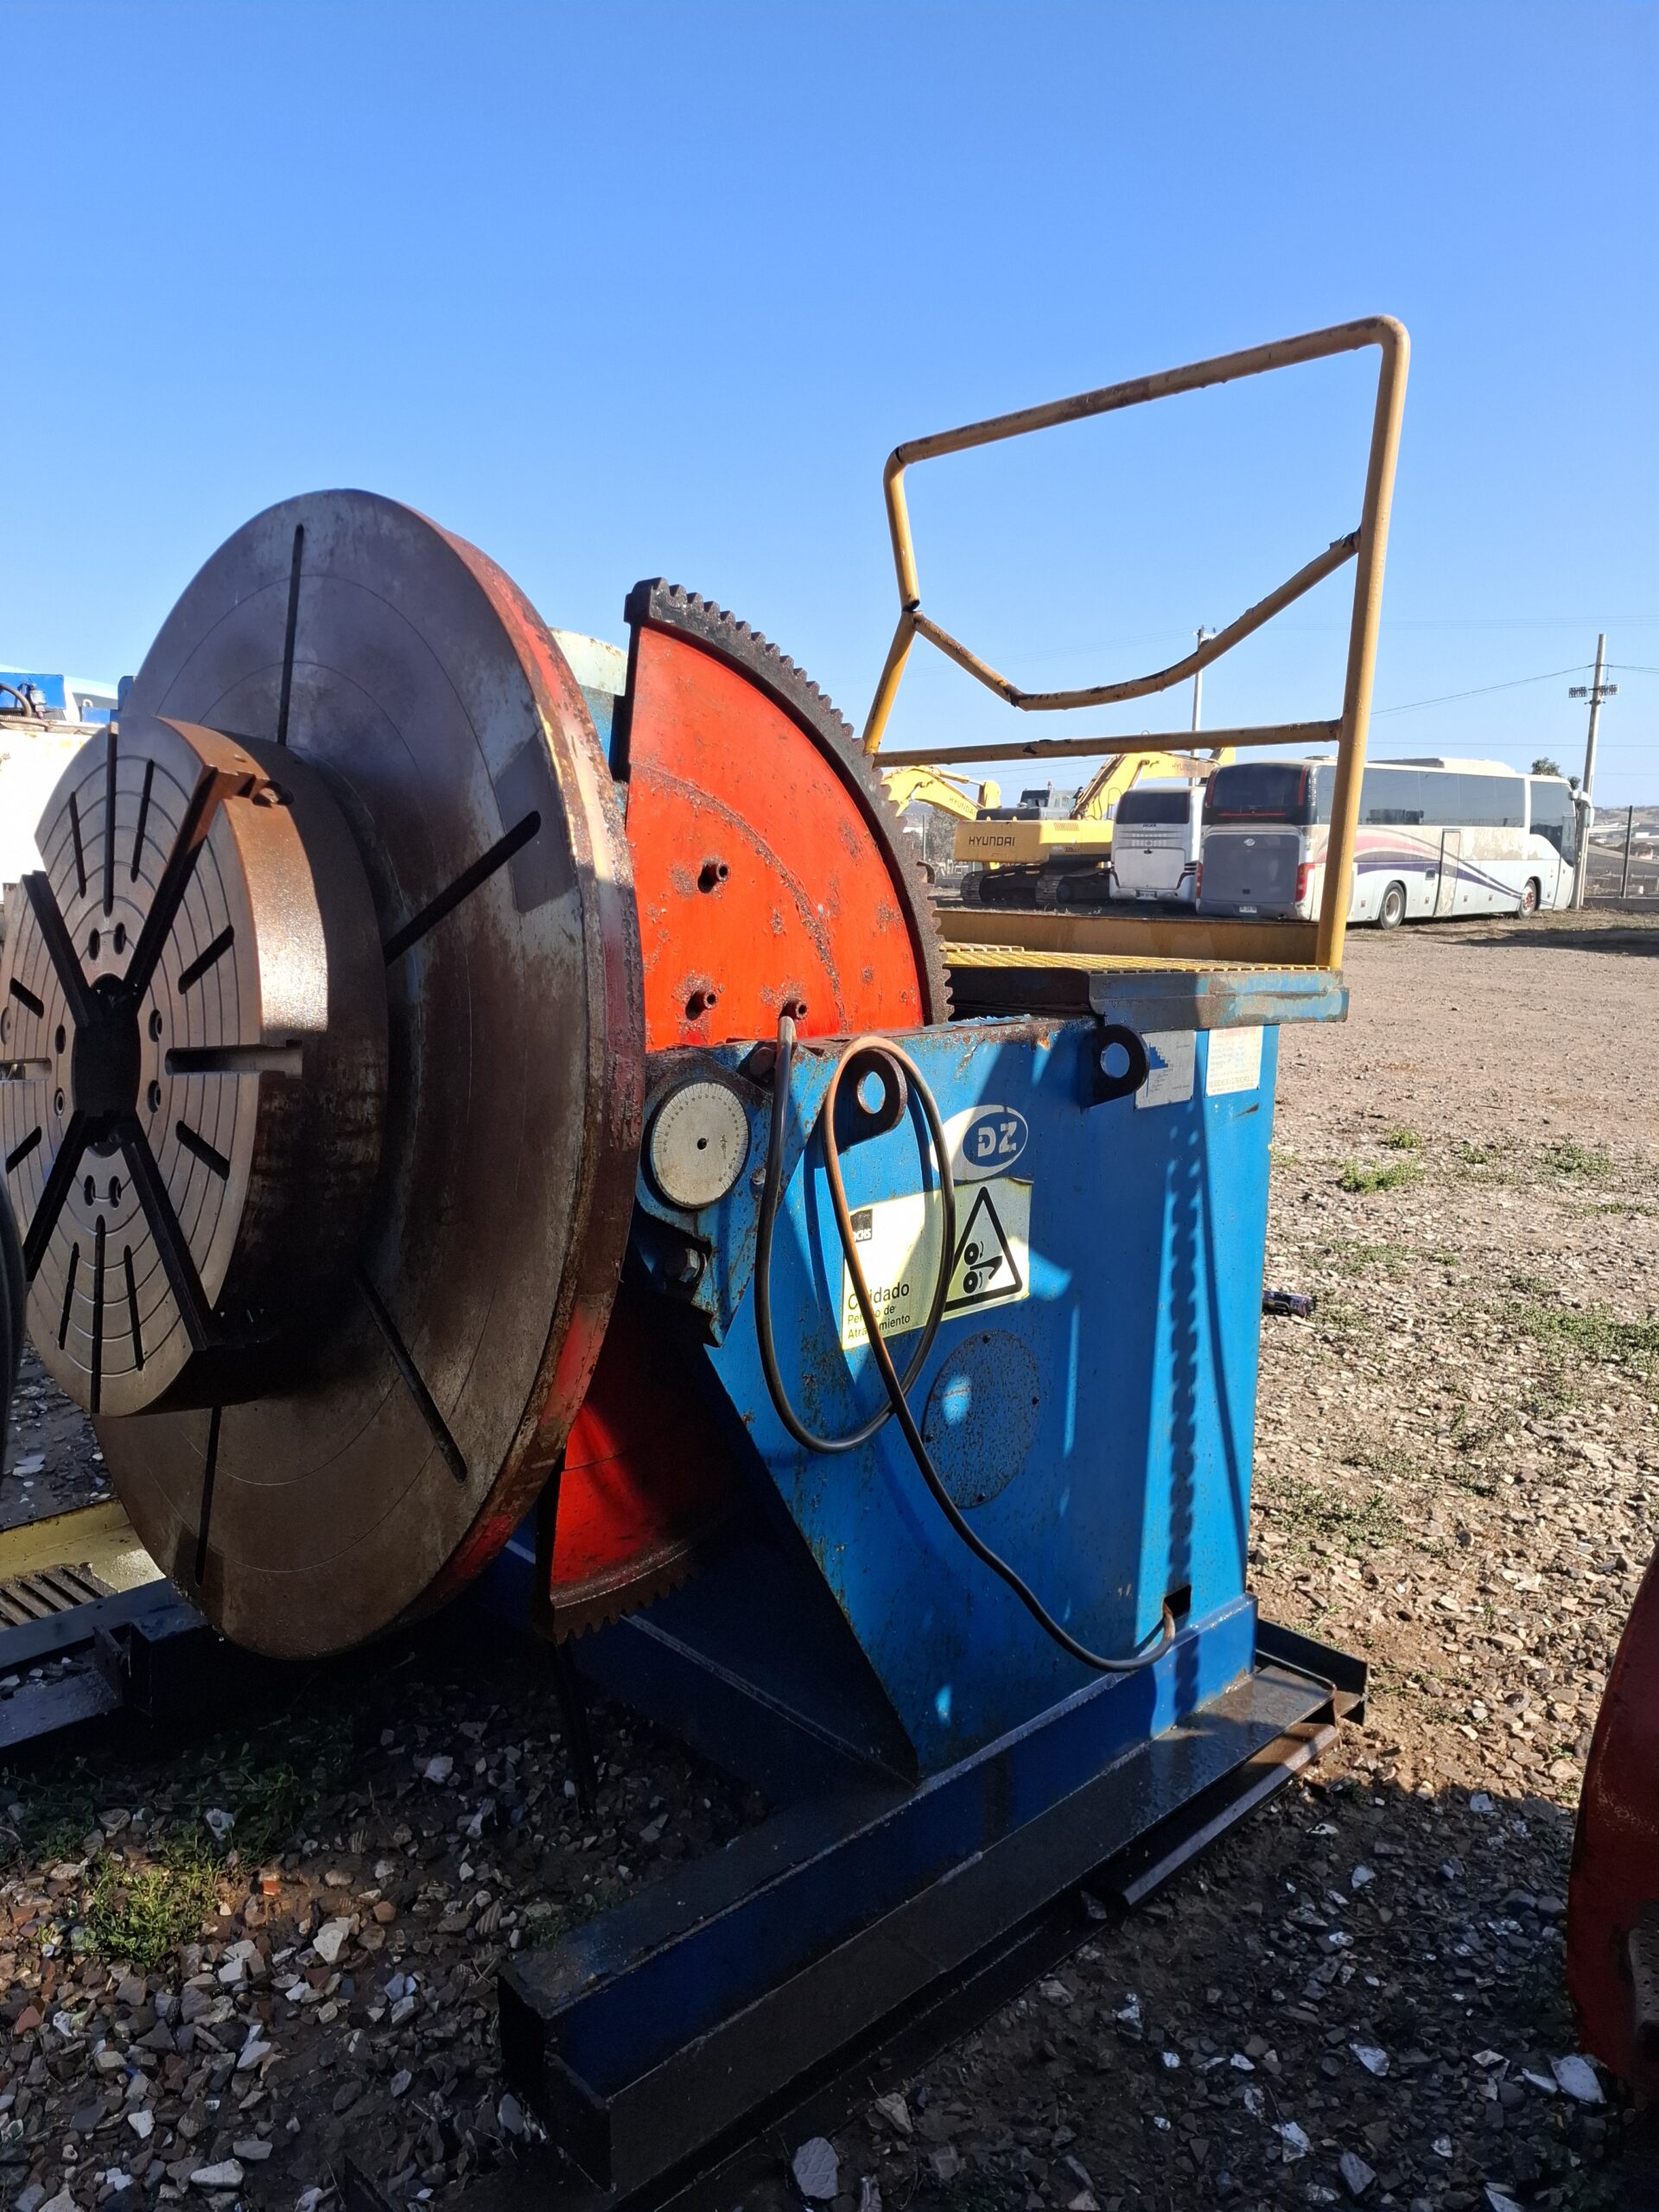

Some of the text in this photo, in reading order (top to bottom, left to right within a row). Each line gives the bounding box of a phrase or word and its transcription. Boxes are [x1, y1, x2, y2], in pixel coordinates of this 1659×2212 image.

[949, 796, 976, 817] HYUNDAI
[968, 836, 1016, 847] HYUNDAI
[977, 1121, 1018, 1158] DZ
[848, 1281, 910, 1310] Cidado
[848, 1305, 896, 1325] Pelo de
[848, 1314, 911, 1339] Atramiento
